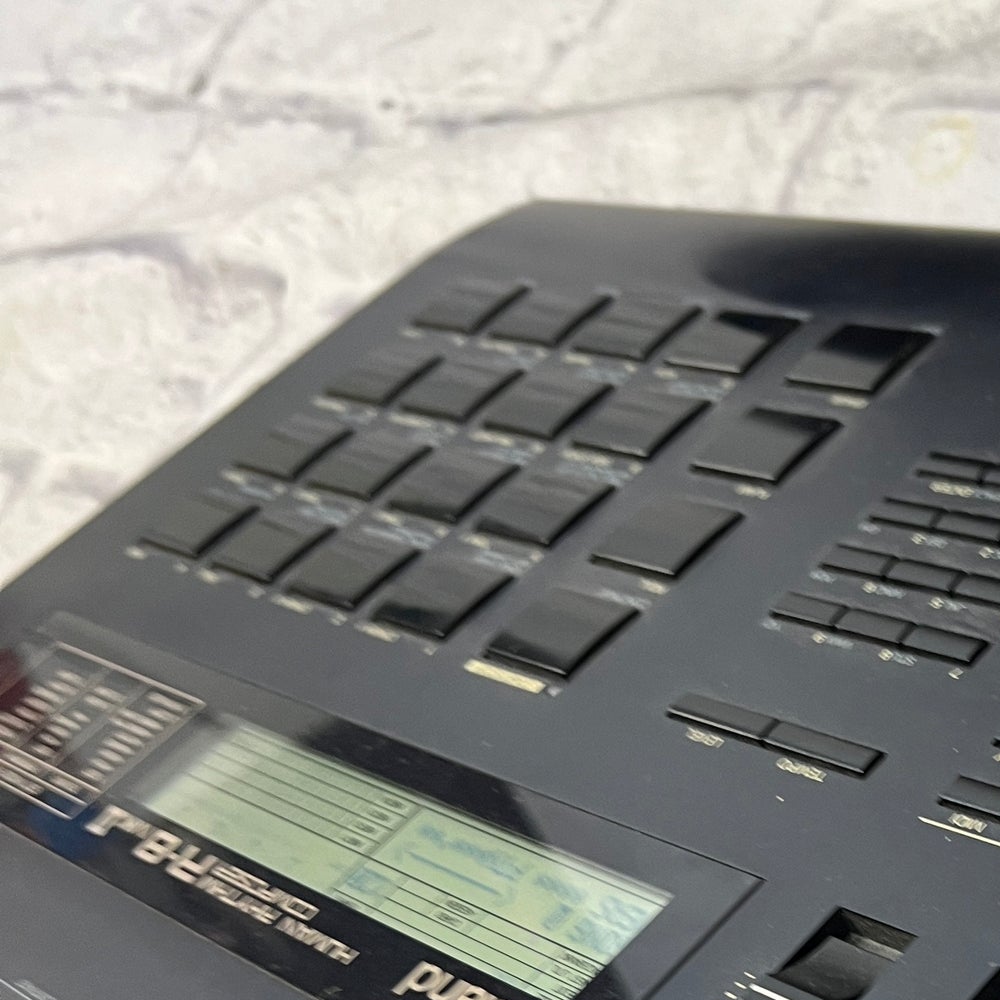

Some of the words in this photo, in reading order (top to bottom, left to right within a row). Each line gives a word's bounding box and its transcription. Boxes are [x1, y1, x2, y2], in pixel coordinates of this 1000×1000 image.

[776, 757, 827, 782] TEMPO
[947, 812, 988, 832] MIDI
[274, 916, 361, 965] HUMAN
